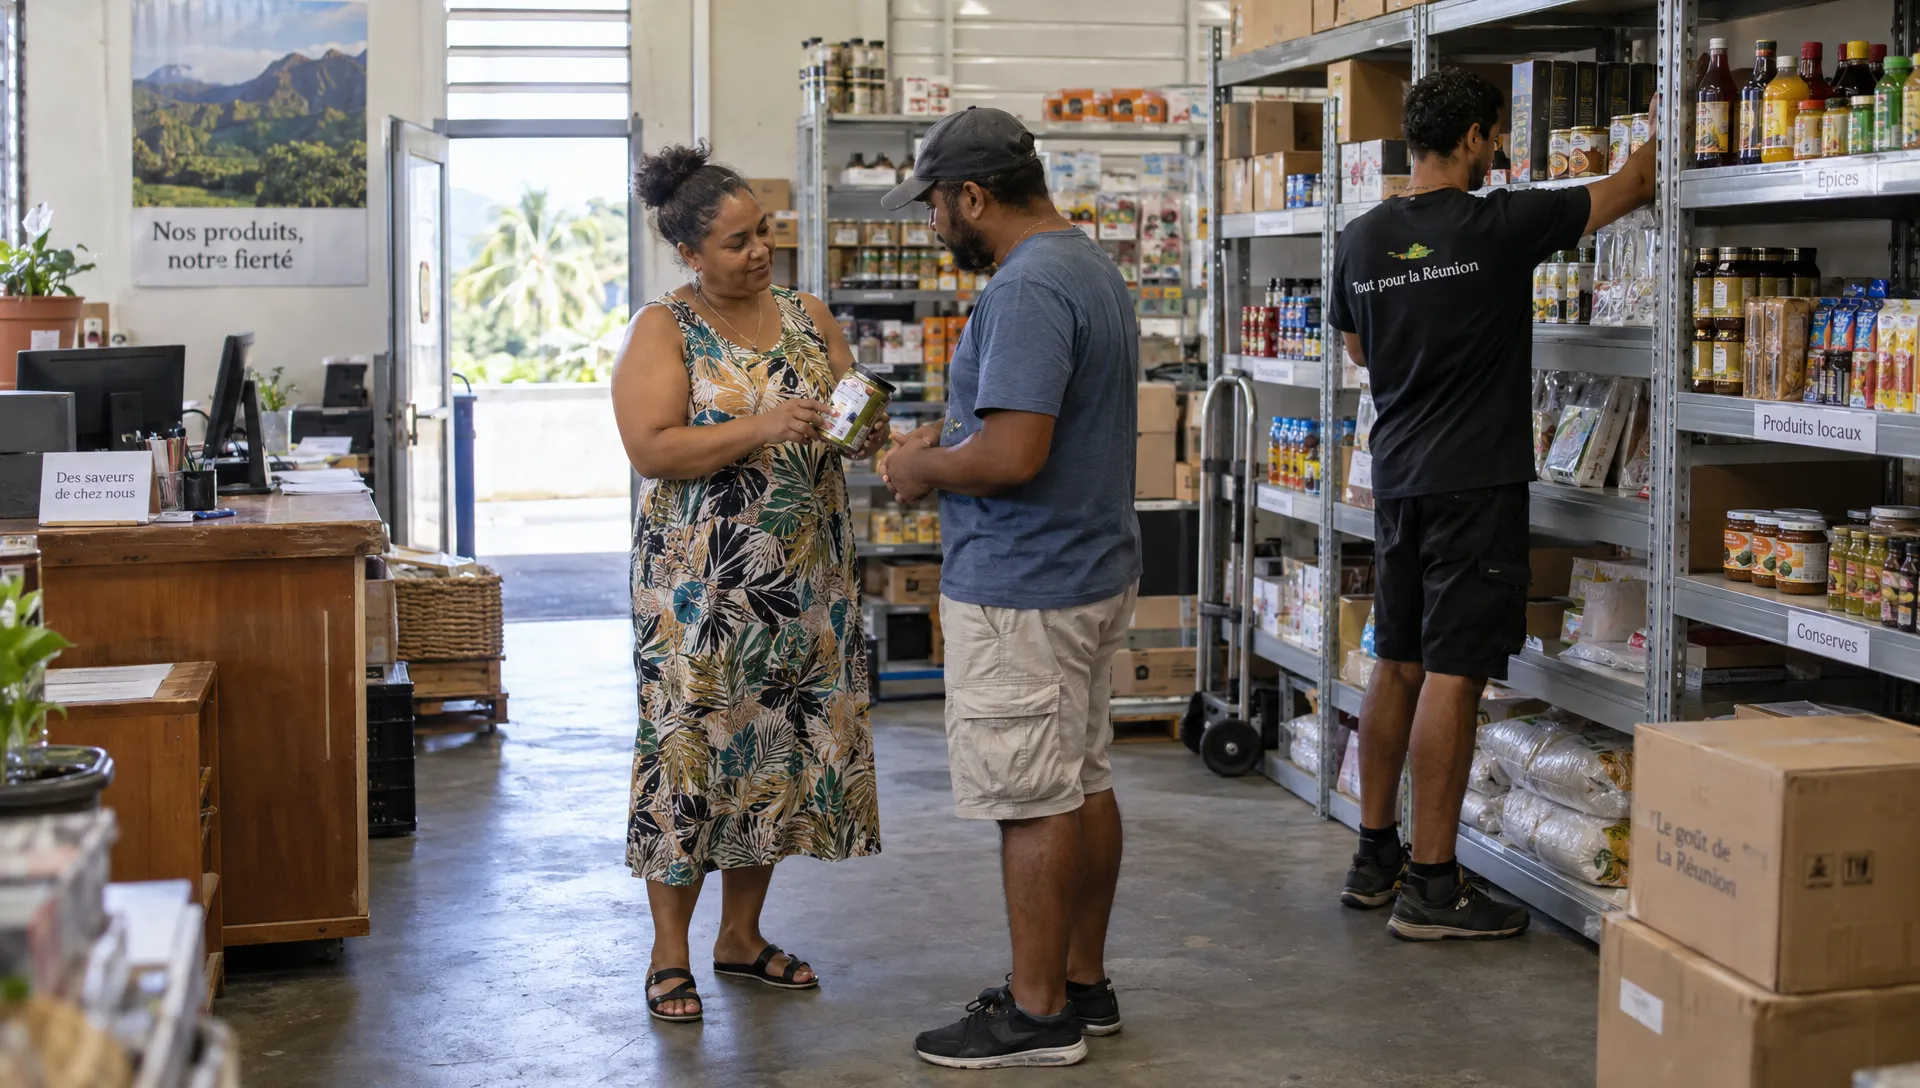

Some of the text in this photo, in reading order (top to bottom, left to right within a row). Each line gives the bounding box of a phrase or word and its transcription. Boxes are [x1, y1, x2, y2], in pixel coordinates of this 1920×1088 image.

[1818, 168, 1859, 193] Épices
[152, 221, 304, 247] Nos produits,
[168, 248, 293, 270] notre fierté
[1352, 261, 1480, 294] Tout pour la Réunion
[1763, 414, 1862, 441] Produits locaux
[56, 472, 135, 483] Des saveurs
[55, 488, 136, 500] de chez nous
[1797, 622, 1858, 653] Conserves
[1656, 840, 1672, 867] La
[1675, 826, 1708, 853] goût
[1712, 836, 1732, 863] de
